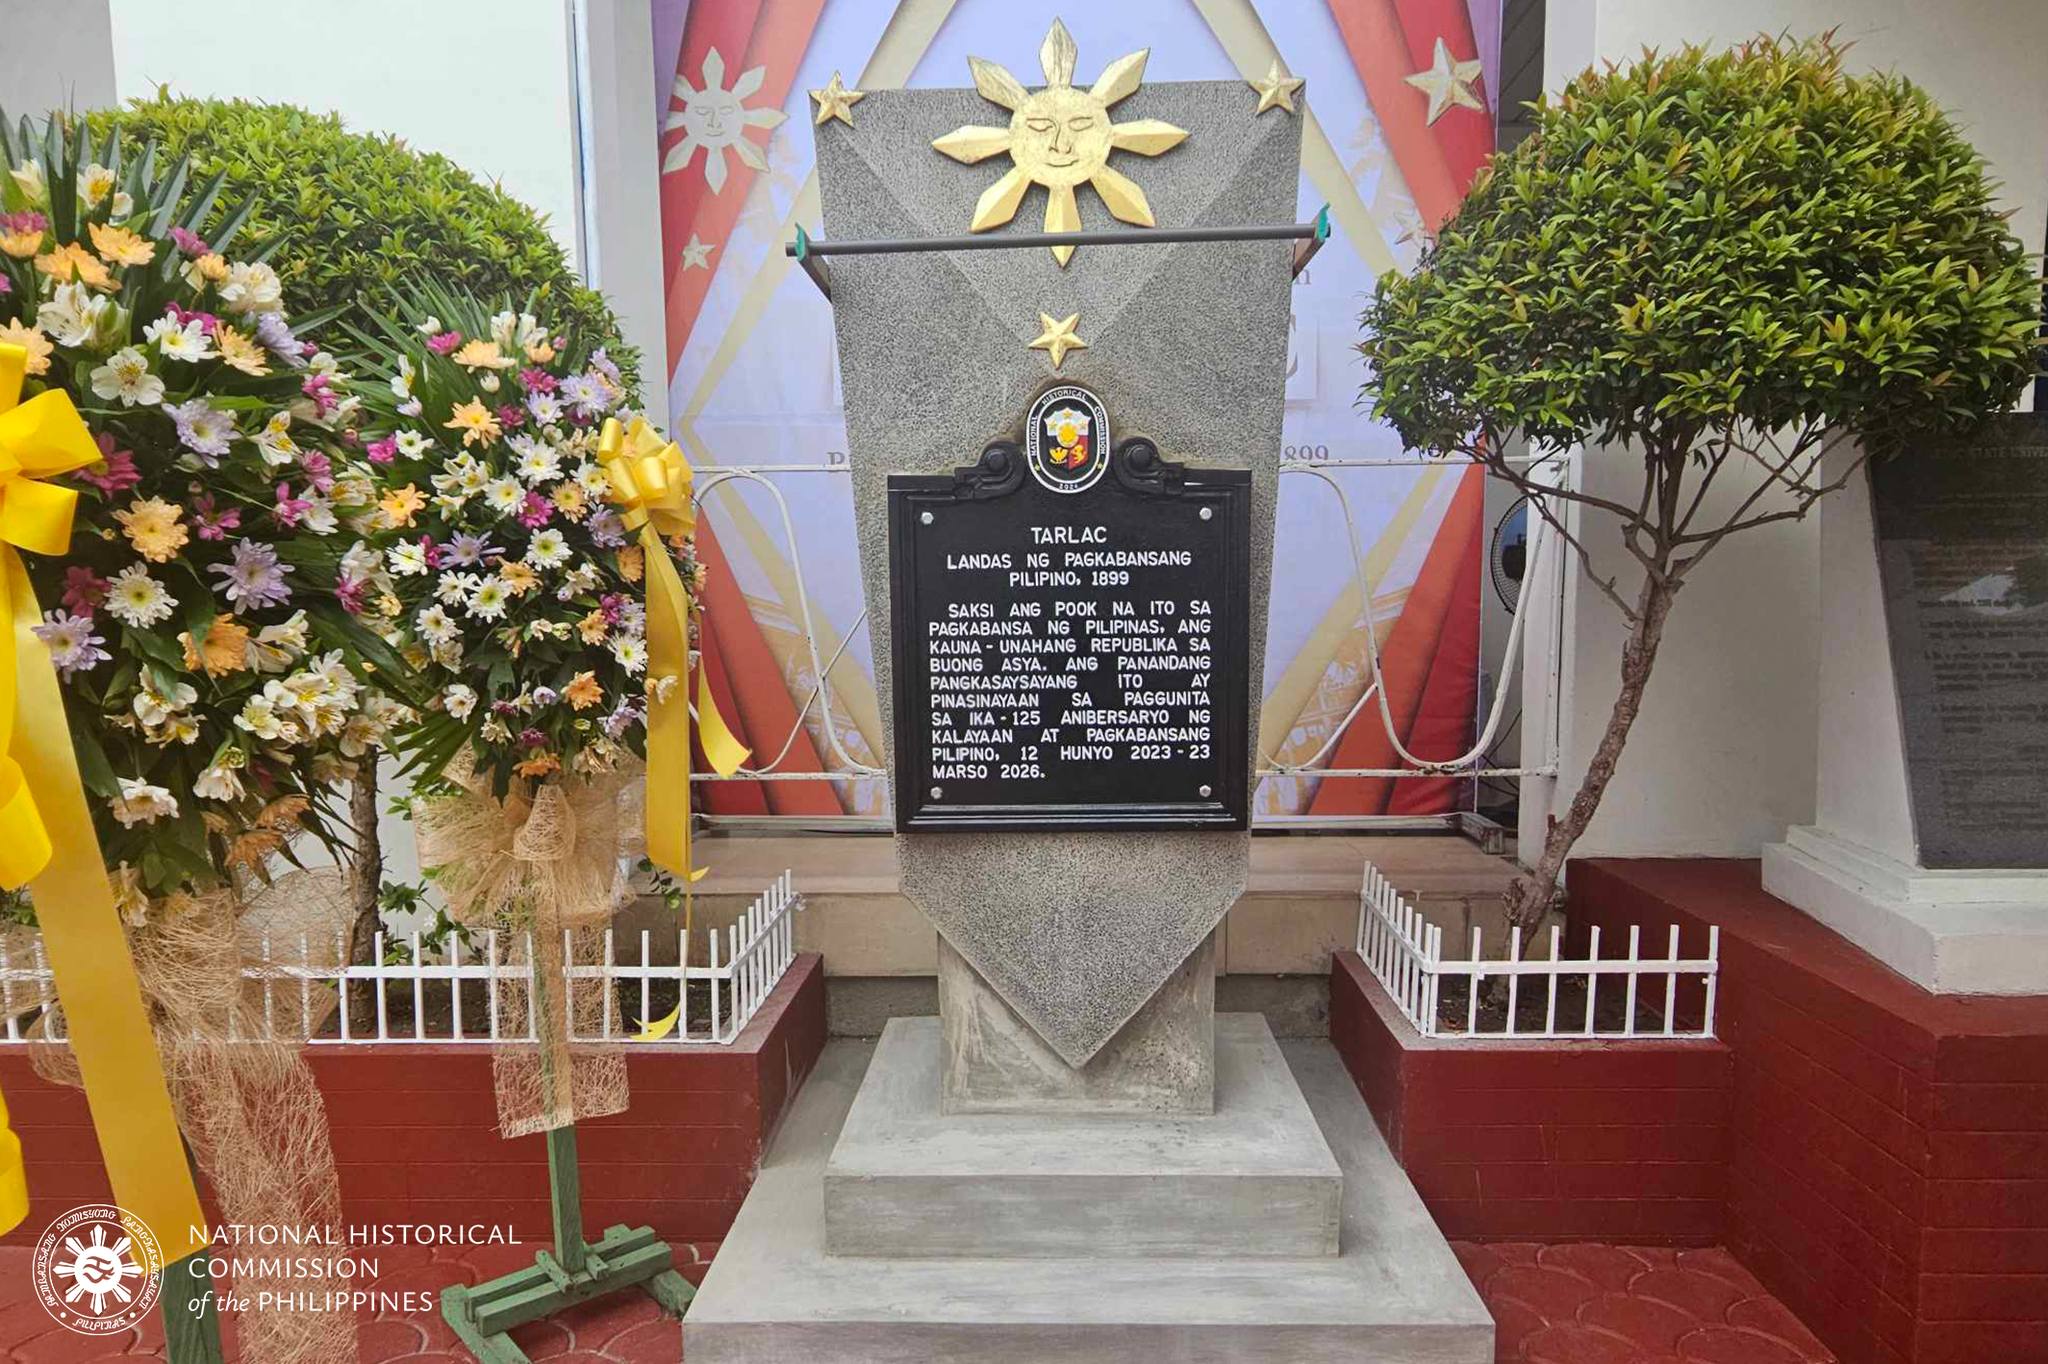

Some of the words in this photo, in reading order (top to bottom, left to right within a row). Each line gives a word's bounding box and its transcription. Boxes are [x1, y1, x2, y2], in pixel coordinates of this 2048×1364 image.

[1030, 415, 1039, 457] NATIONAL
[1030, 526, 1107, 545] TARLAC
[946, 553, 1012, 570] LANDAS
[1026, 552, 1050, 568] NG
[1064, 550, 1192, 568] PAGKABANSANG
[1009, 571, 1082, 588] PILIPINO,
[1091, 570, 1130, 587] 1899
[948, 602, 994, 618] SAKSI
[1009, 601, 1042, 617] ANG
[1054, 601, 1097, 617] POOK
[1112, 600, 1135, 616] NA
[1150, 600, 1175, 616] ITO
[1189, 599, 1212, 615] SA
[928, 620, 1033, 637] PAGKABANSA
[1047, 619, 1070, 636] NG
[1085, 619, 1165, 635] PILIPINAS,
[1177, 618, 1211, 634] ANG
[1090, 637, 1178, 653] REPUBLIKA
[1188, 637, 1211, 652] SA
[929, 657, 984, 673] BUONG
[1001, 656, 1047, 672] ASYA.
[1065, 656, 1099, 672] ANG
[1117, 654, 1211, 671] PANANDANG
[930, 674, 1078, 691] PANGKASAYSAYANG
[1117, 673, 1143, 689] ITO
[1190, 672, 1211, 688] AY
[930, 692, 1039, 709] PINASINAYAAN
[1071, 691, 1093, 707] SA
[1124, 690, 1211, 707] PAGGUNITA
[931, 711, 953, 727] SA
[1060, 709, 1170, 726] ANIBERSARYO
[1188, 709, 1211, 725] NG
[931, 728, 1013, 745] KALAYAAN
[1040, 728, 1060, 743] AT
[1086, 726, 1211, 743] PAGKABANSANG
[931, 746, 1000, 762] PILIPINO,
[1020, 745, 1039, 761] 12
[1060, 745, 1113, 761] HUNYO
[932, 763, 988, 780] MARSO
[1000, 763, 1046, 779] 2026.
